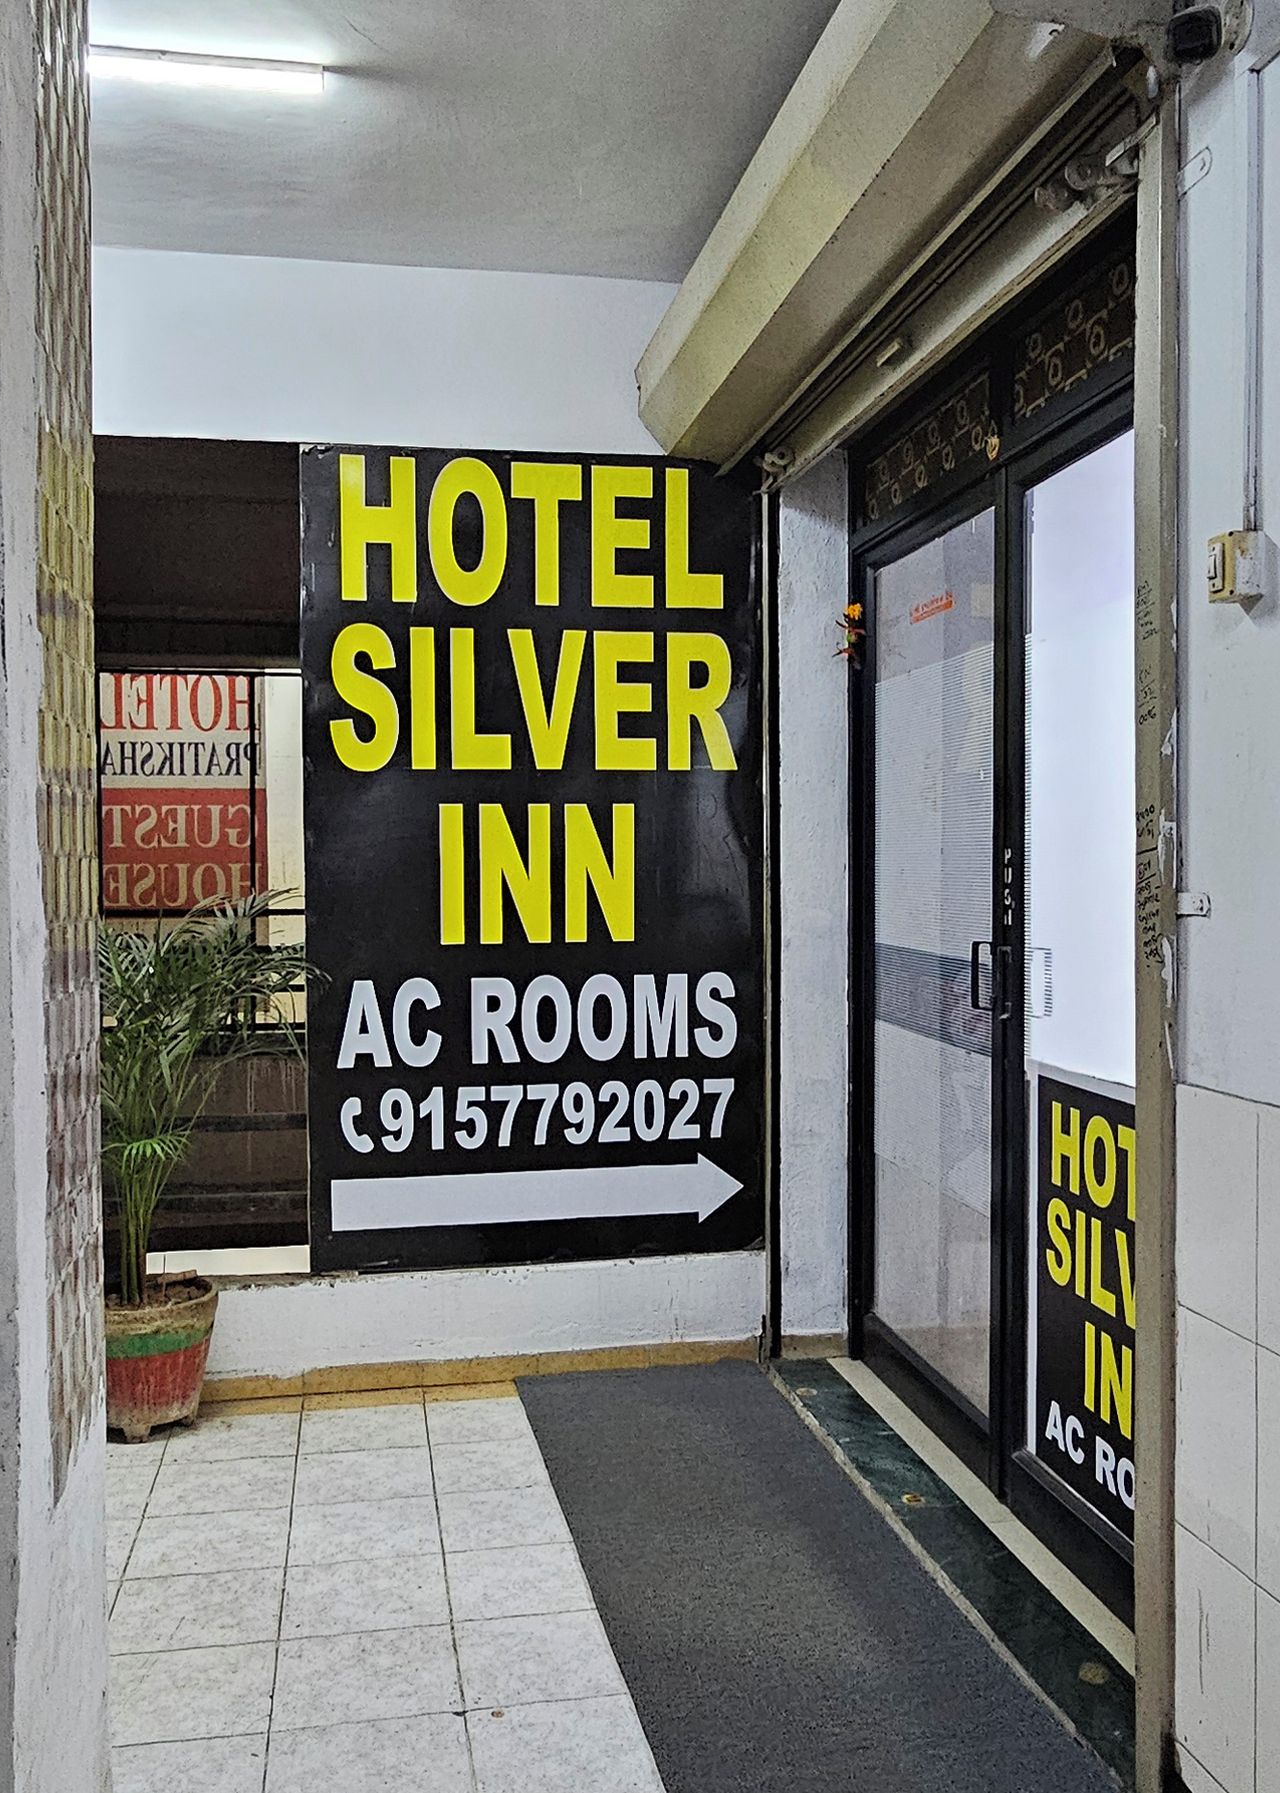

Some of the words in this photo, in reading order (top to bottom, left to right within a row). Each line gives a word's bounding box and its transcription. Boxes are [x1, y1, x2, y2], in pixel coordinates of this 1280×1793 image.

[339, 454, 724, 609] HOTEL
[329, 622, 738, 773] SILVER
[439, 803, 635, 945] INN
[336, 977, 442, 1069] AC
[470, 971, 738, 1065] ROOMS
[379, 1077, 736, 1153] 9157792027
[1045, 1400, 1085, 1465] AC
